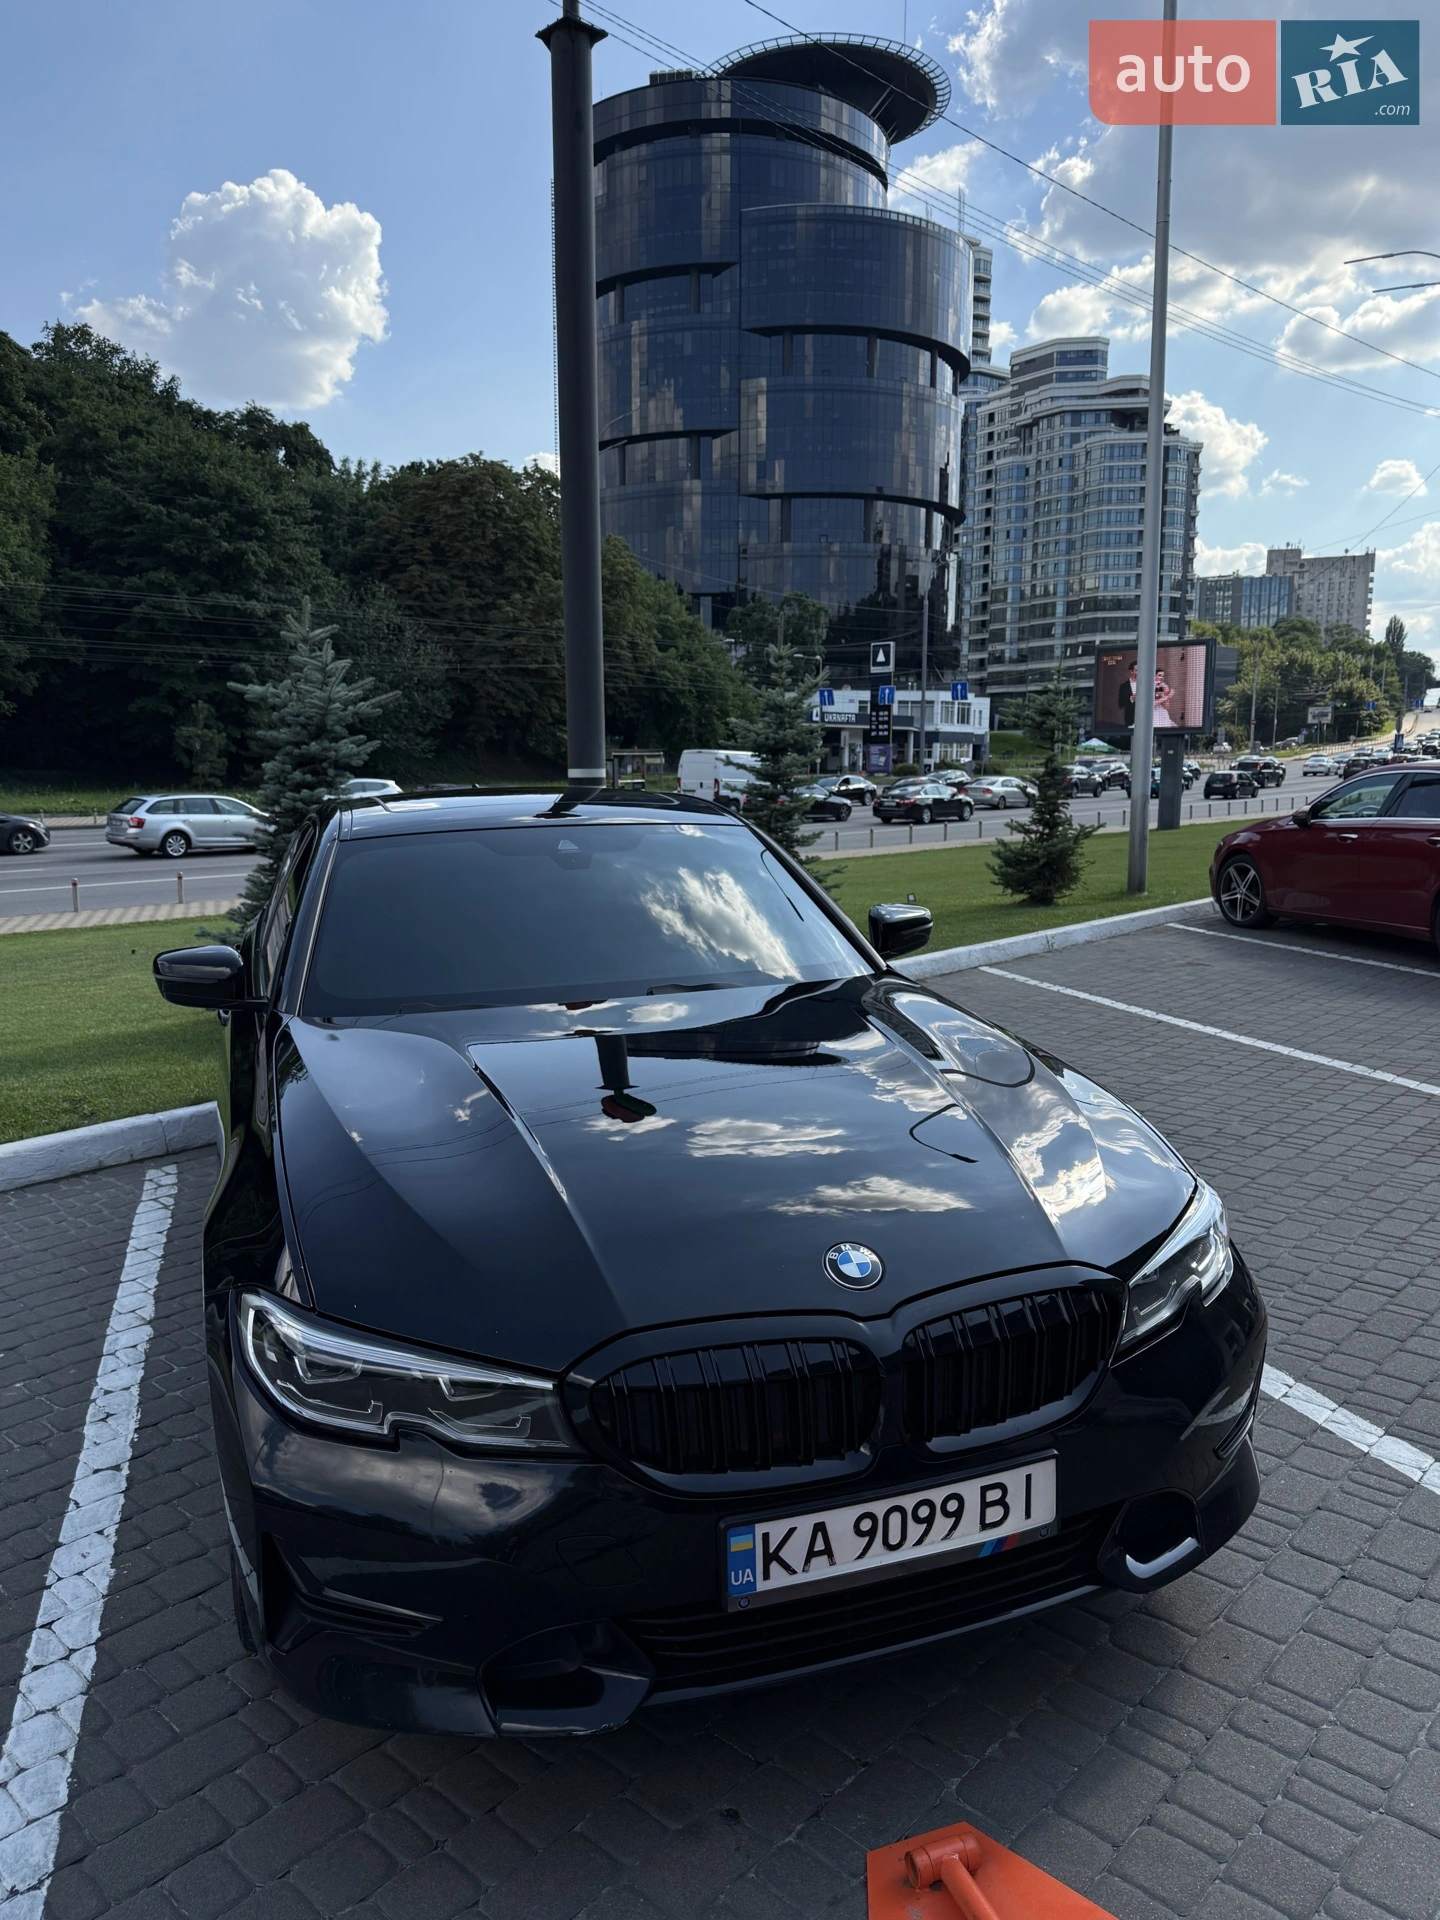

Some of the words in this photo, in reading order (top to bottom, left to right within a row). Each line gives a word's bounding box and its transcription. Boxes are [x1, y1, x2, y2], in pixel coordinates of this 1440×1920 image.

[824, 712, 856, 723] UKRNAFTA
[829, 1244, 877, 1260] BMW
[761, 1521, 837, 1581] KA
[852, 1492, 965, 1561] 9099
[978, 1473, 1032, 1532] BI
[730, 1568, 755, 1586] UA
